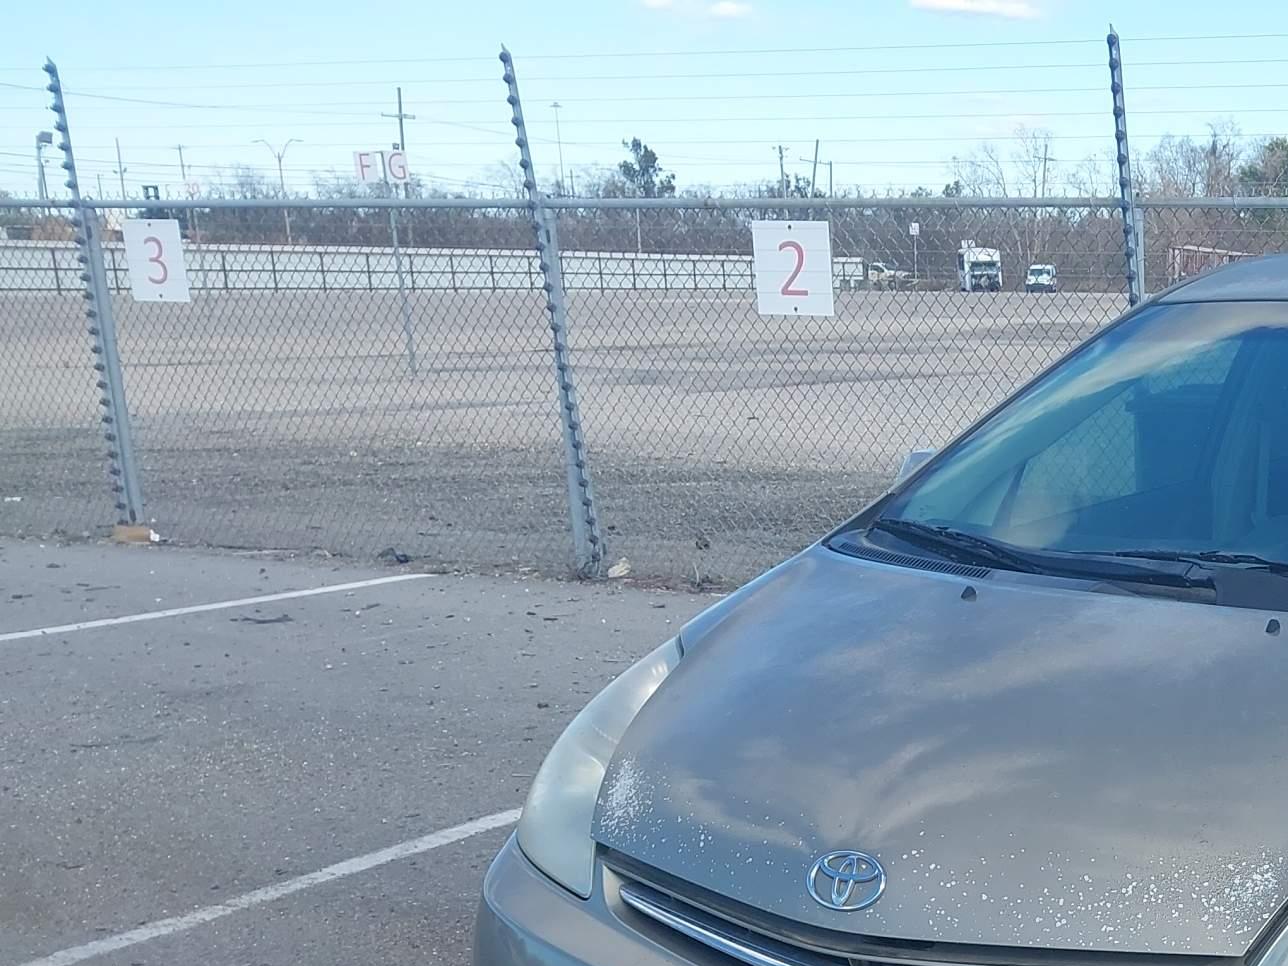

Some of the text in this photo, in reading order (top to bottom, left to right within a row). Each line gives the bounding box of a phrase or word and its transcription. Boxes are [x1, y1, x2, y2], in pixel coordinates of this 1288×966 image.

[359, 152, 371, 181] F
[388, 152, 407, 180] G
[143, 236, 168, 284] 3
[778, 240, 809, 296] 2
